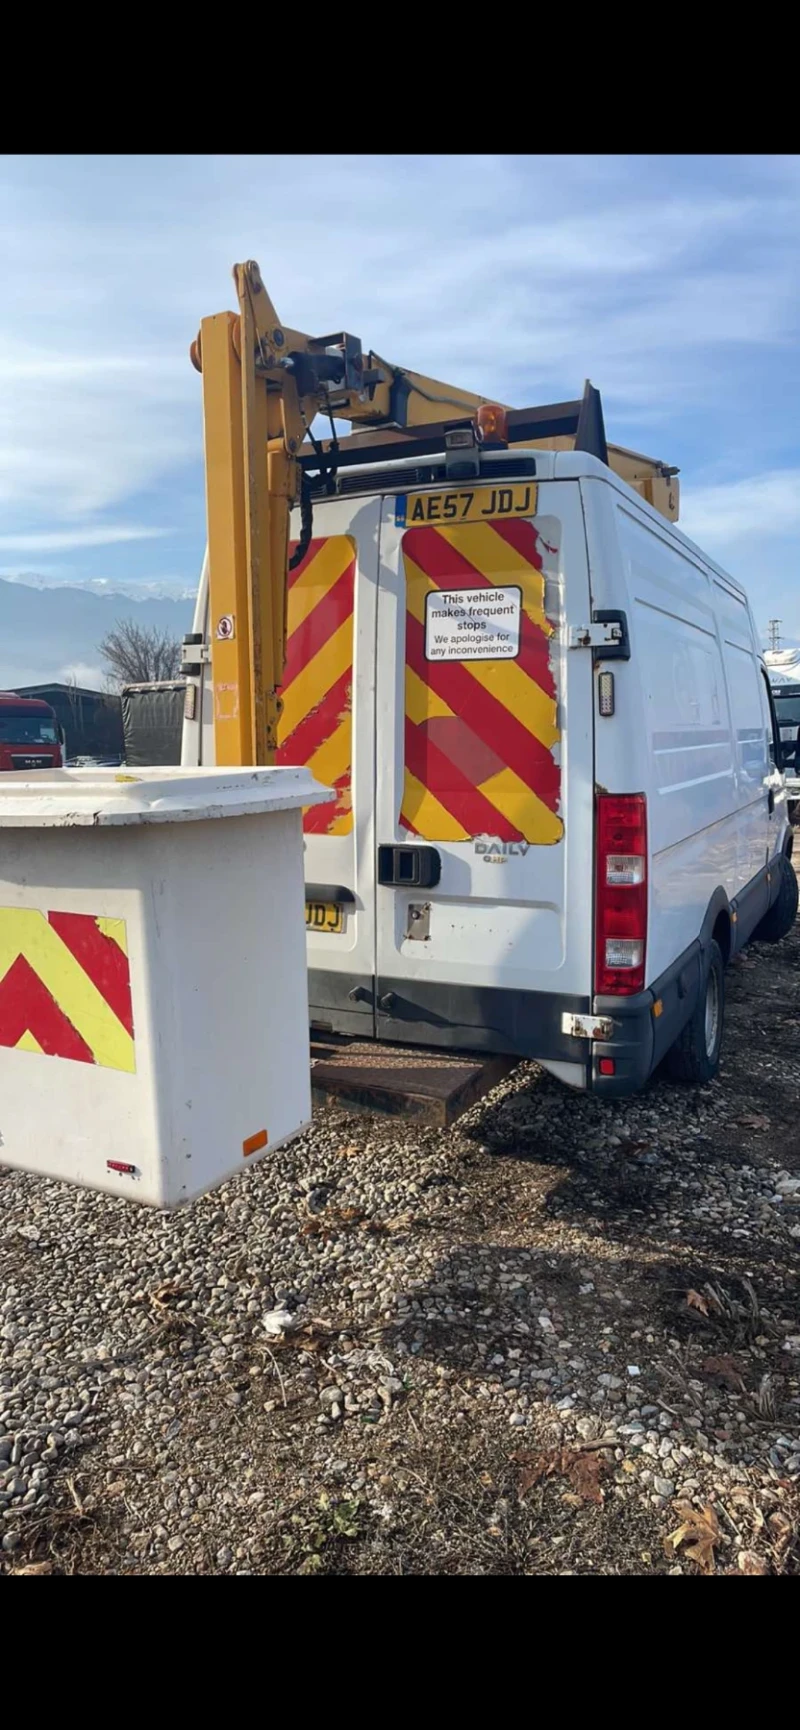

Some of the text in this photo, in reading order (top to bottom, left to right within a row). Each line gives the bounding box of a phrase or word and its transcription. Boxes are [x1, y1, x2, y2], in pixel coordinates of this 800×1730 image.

[411, 487, 531, 521] AE57 JDJ
[442, 592, 505, 604] This vehicle
[431, 605, 515, 618] makes frequent
[457, 621, 487, 632] stops
[434, 632, 510, 645] We apologise for
[430, 645, 514, 657] any inconvenience
[474, 842, 531, 857] DAILY
